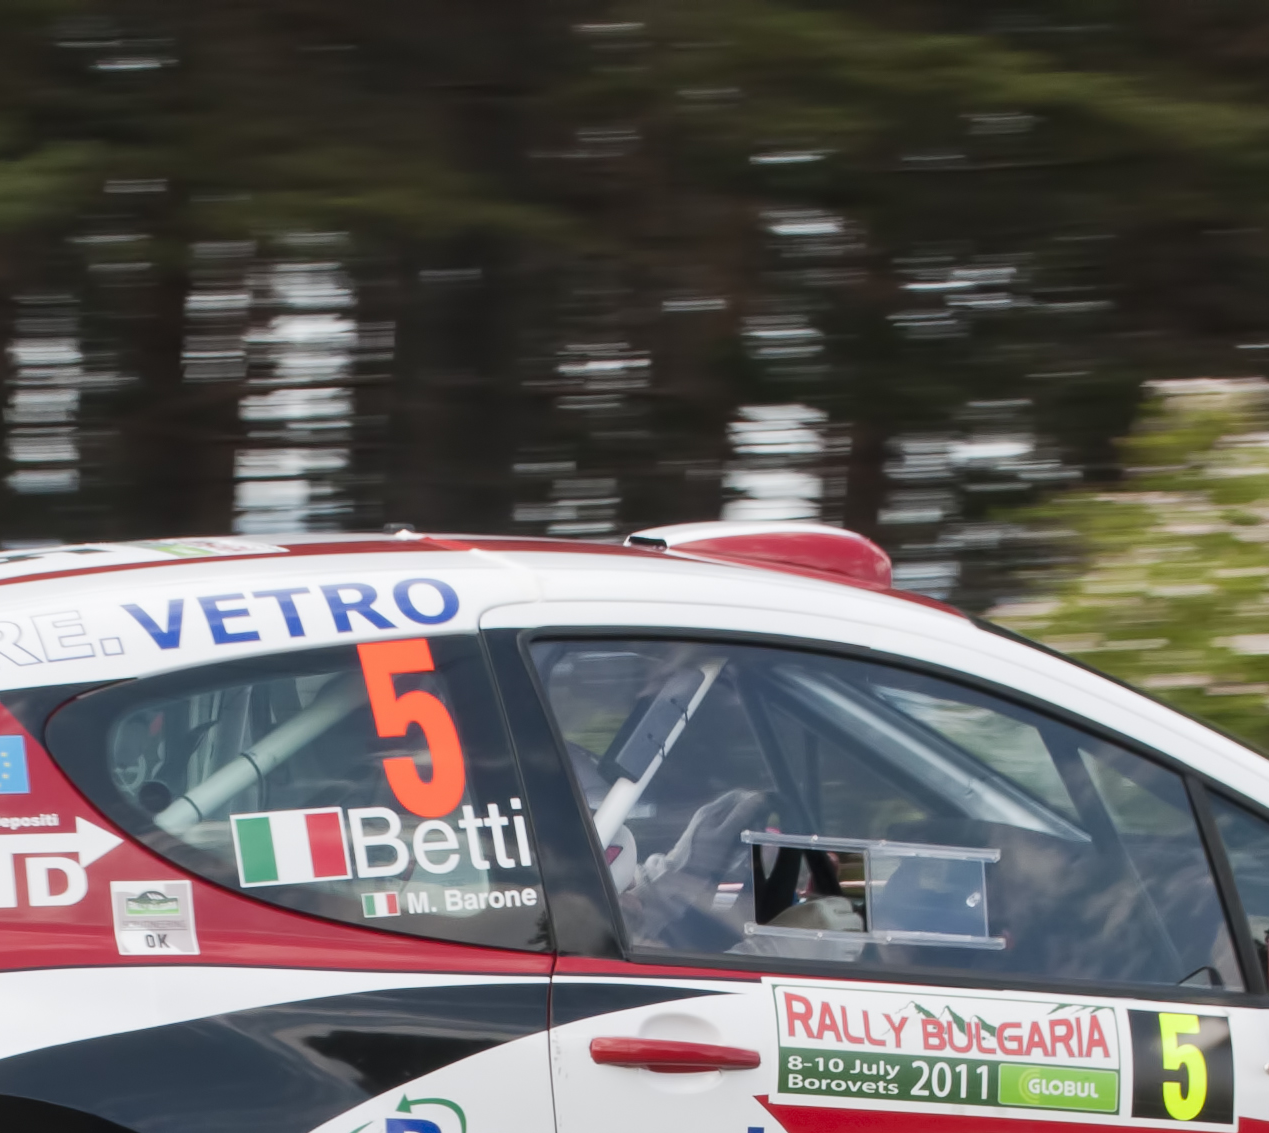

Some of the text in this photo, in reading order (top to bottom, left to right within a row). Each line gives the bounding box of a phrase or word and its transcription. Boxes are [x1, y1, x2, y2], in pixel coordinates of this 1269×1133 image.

[356, 638, 465, 818] 5
[347, 797, 532, 879] Betti
[406, 887, 538, 914] M. Barone
[145, 933, 171, 949] OK
[783, 991, 1111, 1058] RALLY BULGARIA
[787, 1054, 900, 1080] 8-10 July
[909, 1060, 990, 1100] 2011
[1158, 1012, 1208, 1121] 5
[787, 1072, 900, 1095] Borovets
[1027, 1077, 1100, 1099] GLOBUL
